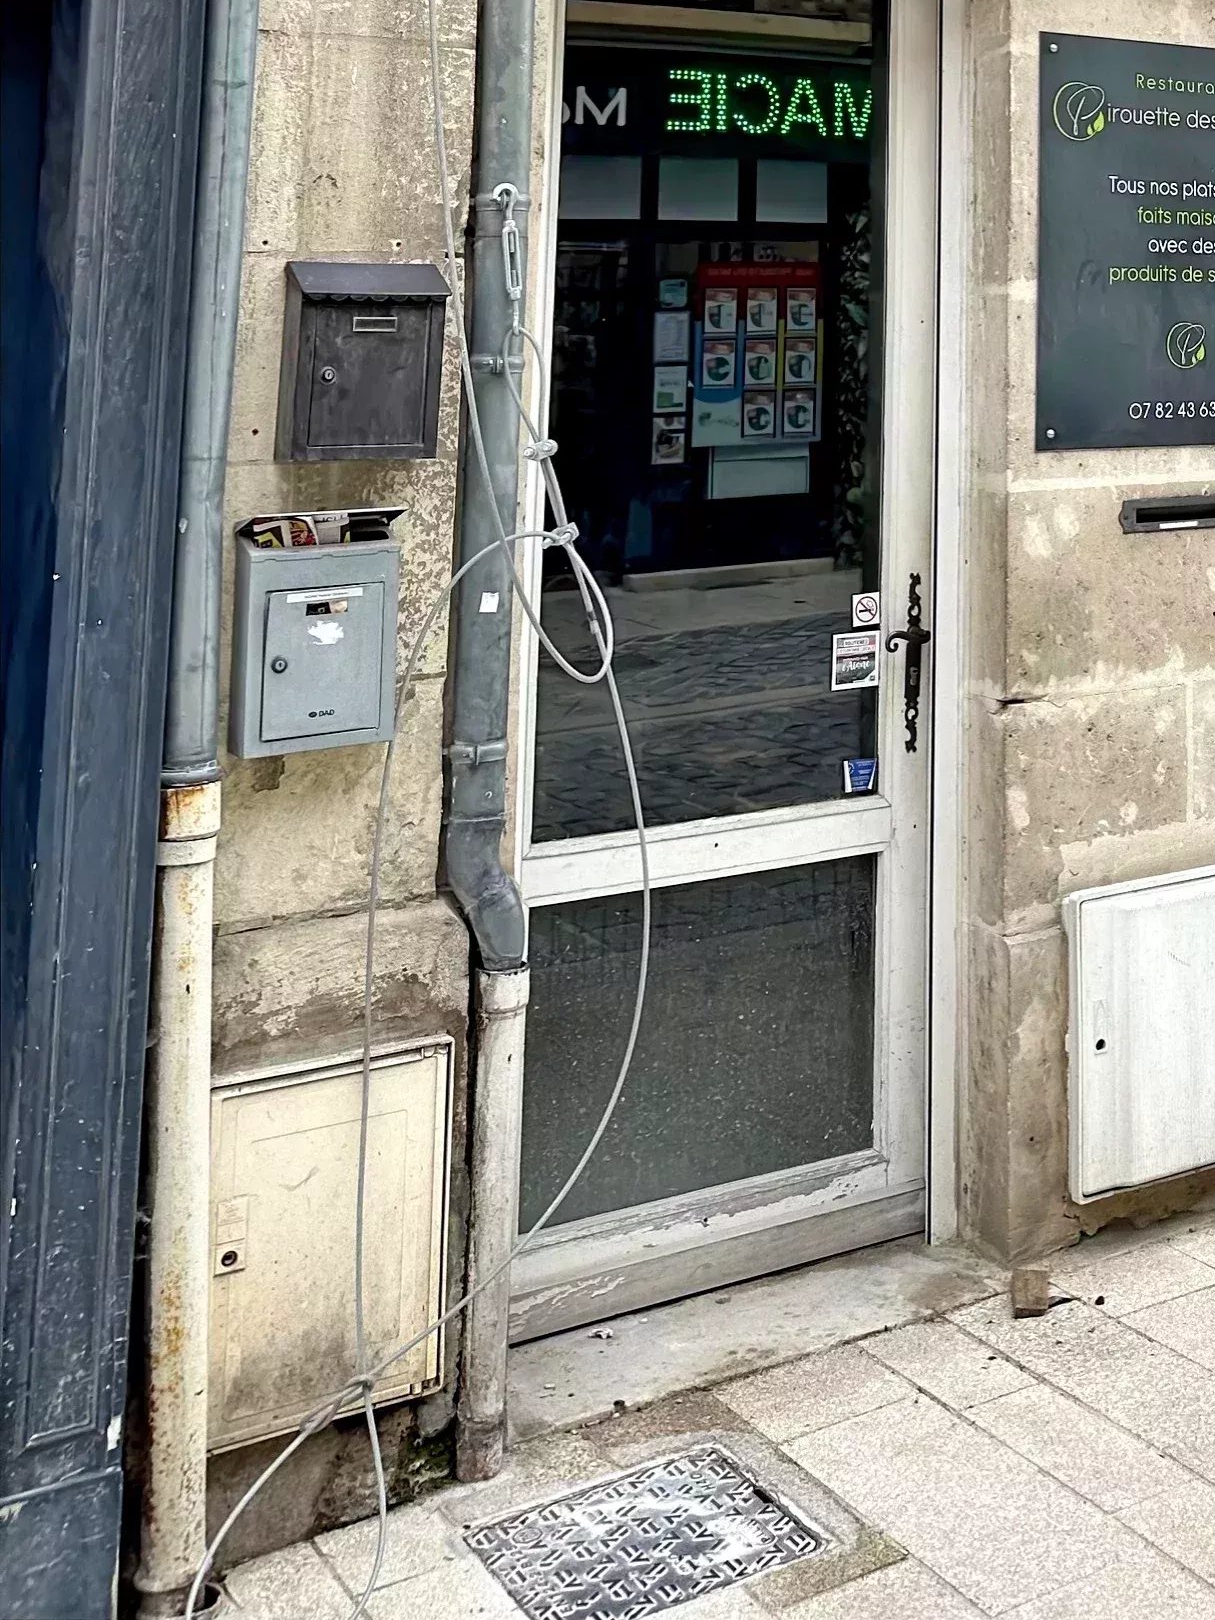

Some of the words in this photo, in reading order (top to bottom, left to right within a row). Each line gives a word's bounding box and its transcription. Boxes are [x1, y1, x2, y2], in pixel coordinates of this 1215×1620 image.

[1108, 175, 1146, 196] Tous
[1149, 180, 1179, 197] nos
[1137, 206, 1172, 226] faits
[1147, 237, 1188, 255] avec
[1108, 264, 1177, 286] produits
[1181, 266, 1204, 283] de
[1128, 402, 1152, 420] 07
[1154, 402, 1174, 419] 82
[1177, 401, 1196, 419] 43
